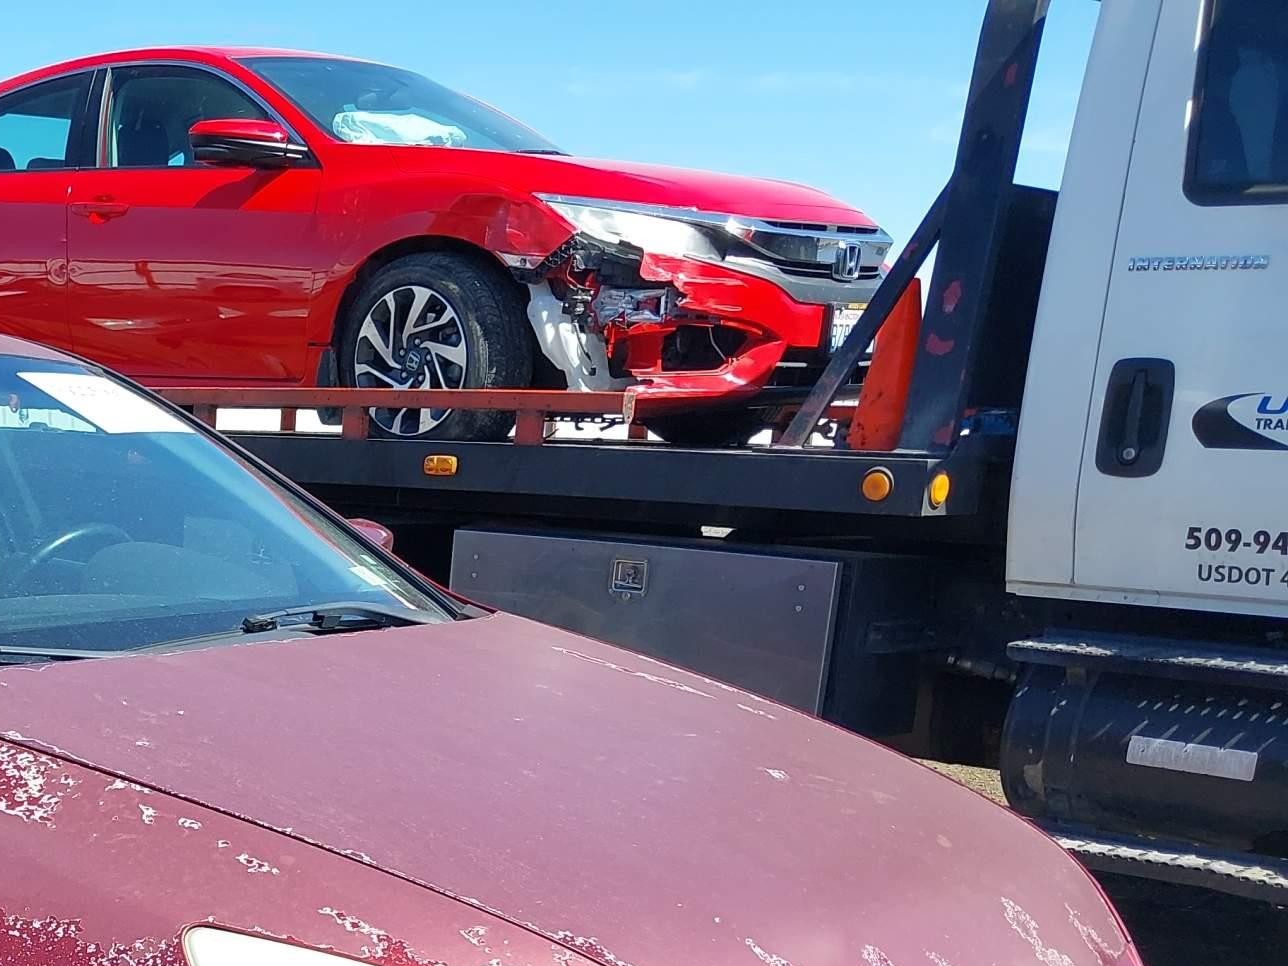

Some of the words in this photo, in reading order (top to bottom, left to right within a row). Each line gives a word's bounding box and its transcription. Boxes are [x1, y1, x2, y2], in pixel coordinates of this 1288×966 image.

[1255, 418, 1288, 431] TRA
[1184, 526, 1288, 556] 509-94
[1197, 563, 1275, 587] USDOT
